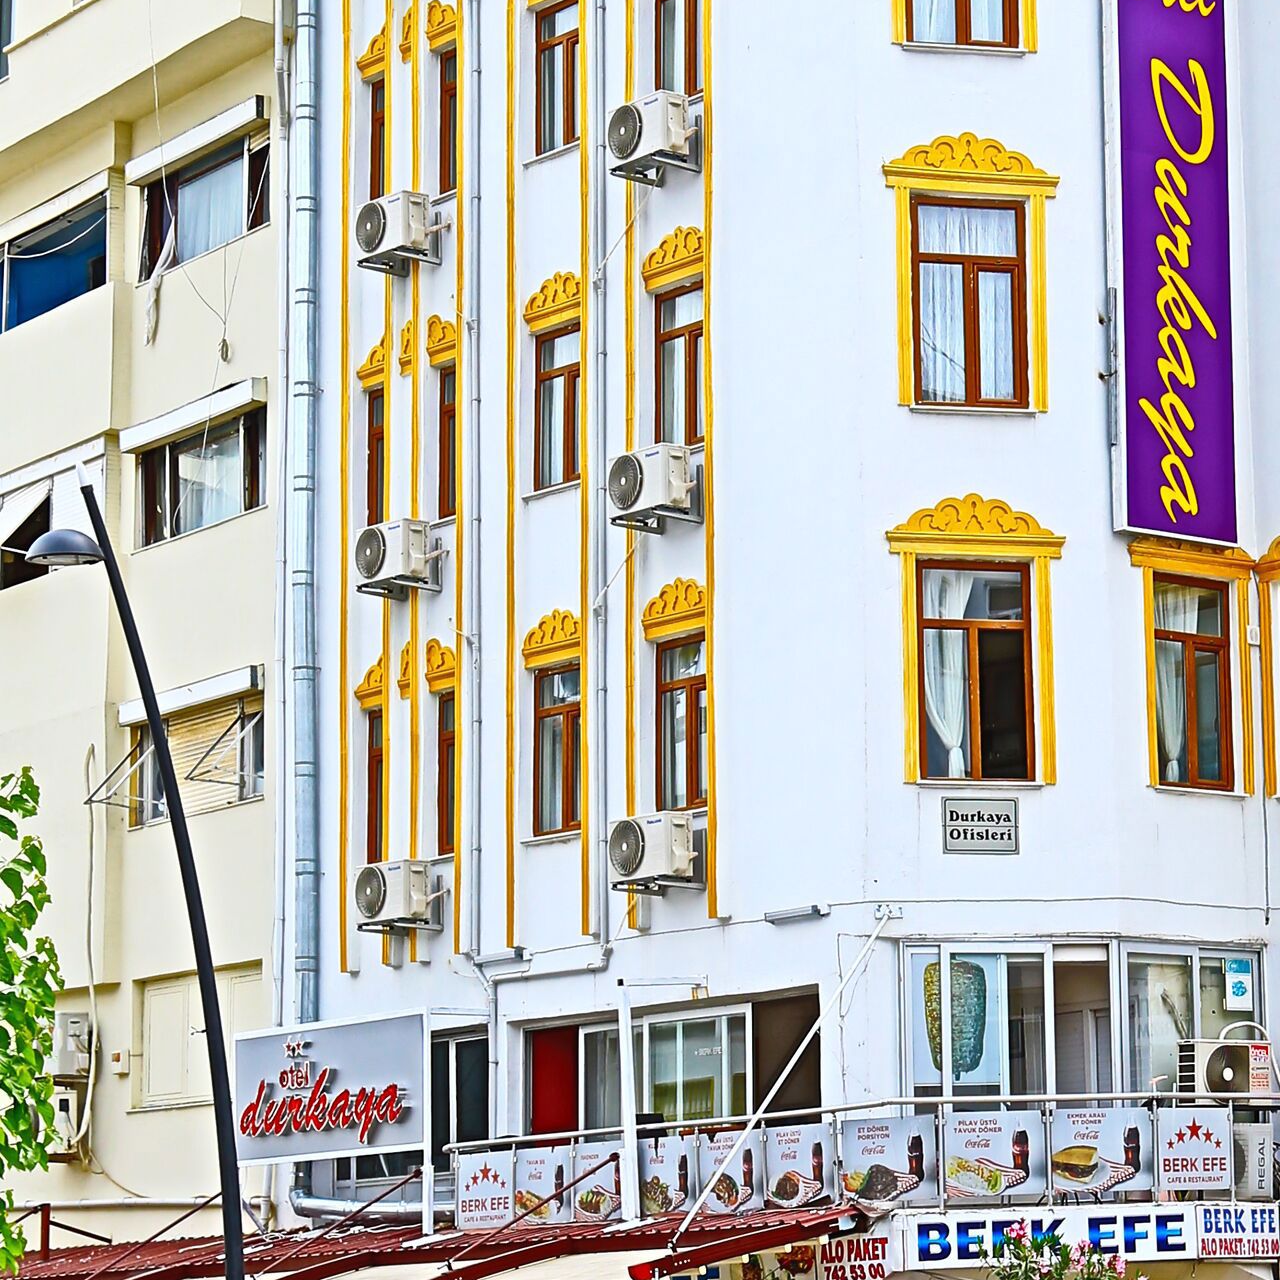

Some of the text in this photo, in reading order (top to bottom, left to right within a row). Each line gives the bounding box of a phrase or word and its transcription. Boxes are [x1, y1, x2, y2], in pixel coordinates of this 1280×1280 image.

[1137, 56, 1217, 525] Durkaya
[949, 810, 1012, 825] Durkaya
[949, 828, 1012, 840] Ofisleri
[239, 1066, 403, 1145] durkaya
[1163, 1157, 1227, 1173] BERK EFE
[1257, 1137, 1266, 1190] REGAL
[1167, 1176, 1182, 1184] CAFE
[1188, 1175, 1224, 1183] RESTAURANT
[461, 1196, 509, 1213] BERK EFE
[1203, 1208, 1277, 1234] BERK EFE
[1088, 1213, 1186, 1254] EFE
[820, 1237, 888, 1264] ALO PAKET
[1201, 1238, 1217, 1256] ALO
[1247, 1238, 1260, 1254] 742
[1261, 1238, 1269, 1254] 53
[1271, 1238, 1279, 1253] 00
[850, 1264, 867, 1280] 53
[868, 1263, 885, 1279] 00
